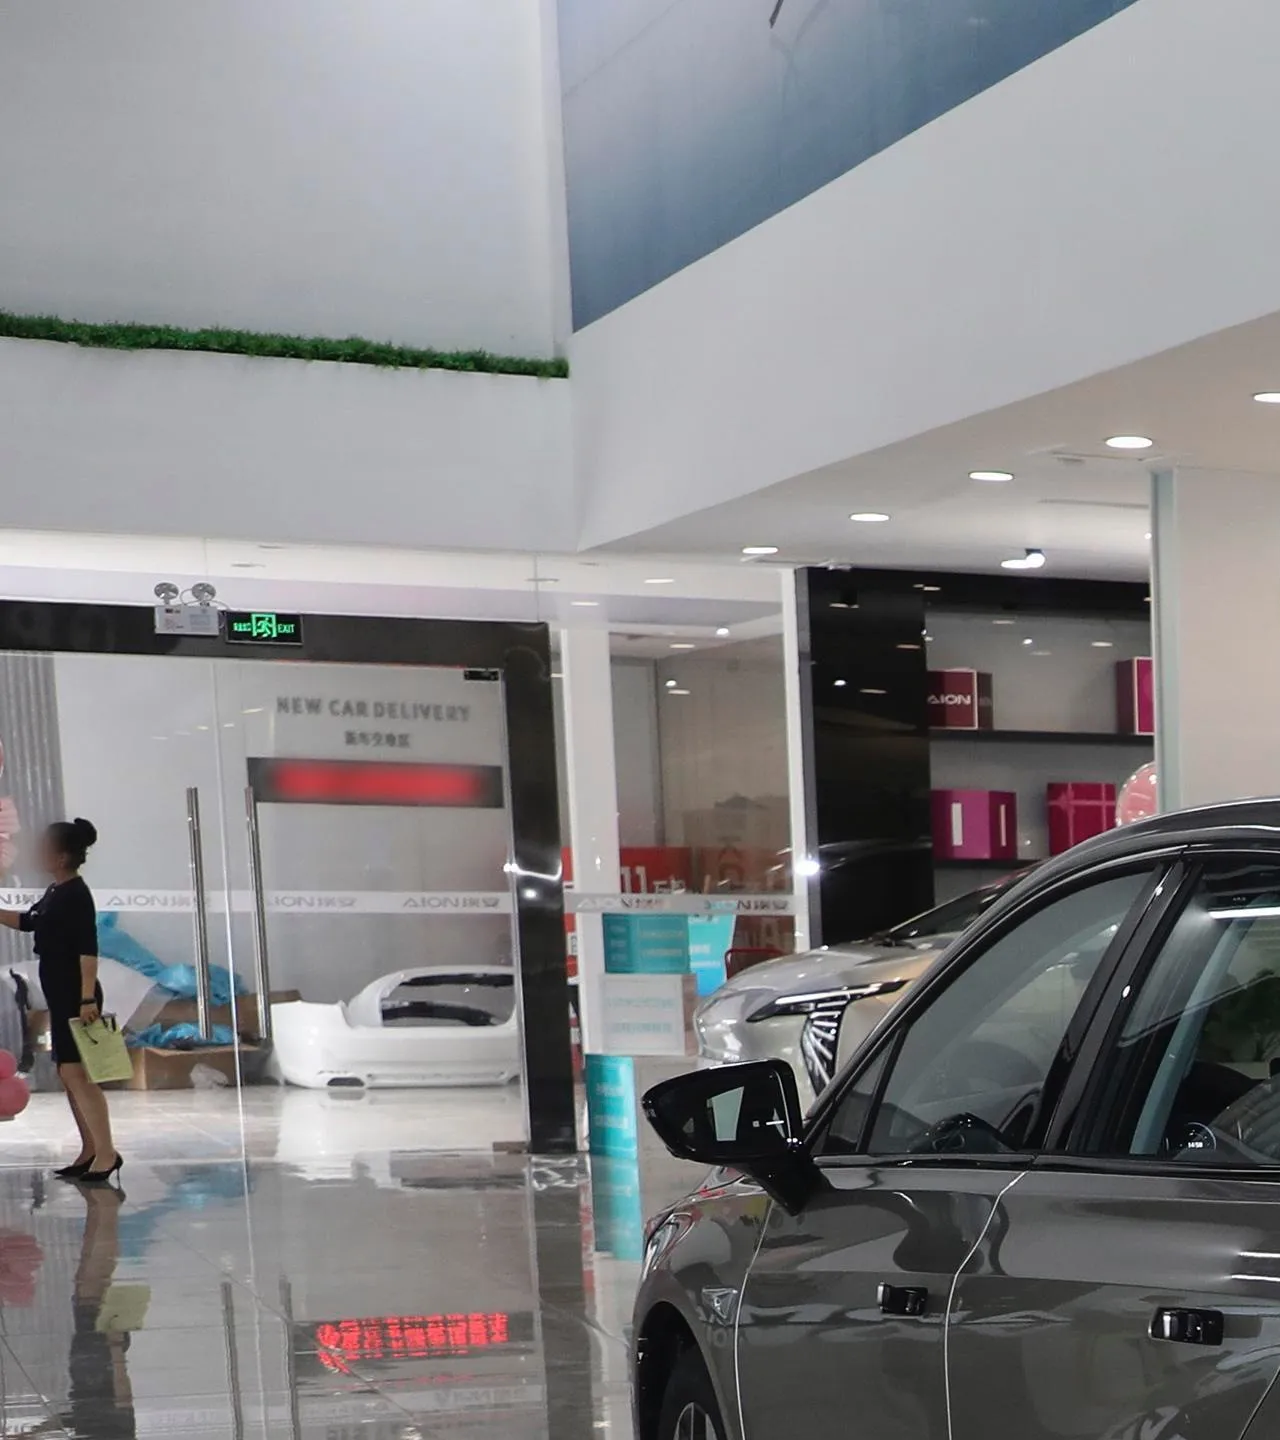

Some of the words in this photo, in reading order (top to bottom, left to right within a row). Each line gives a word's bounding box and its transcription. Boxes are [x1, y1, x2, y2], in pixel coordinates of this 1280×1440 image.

[277, 623, 295, 633] EXIT
[927, 693, 971, 706] AION
[277, 696, 322, 715] NEW
[328, 699, 369, 717] CAR
[374, 702, 471, 722] DELIVERY
